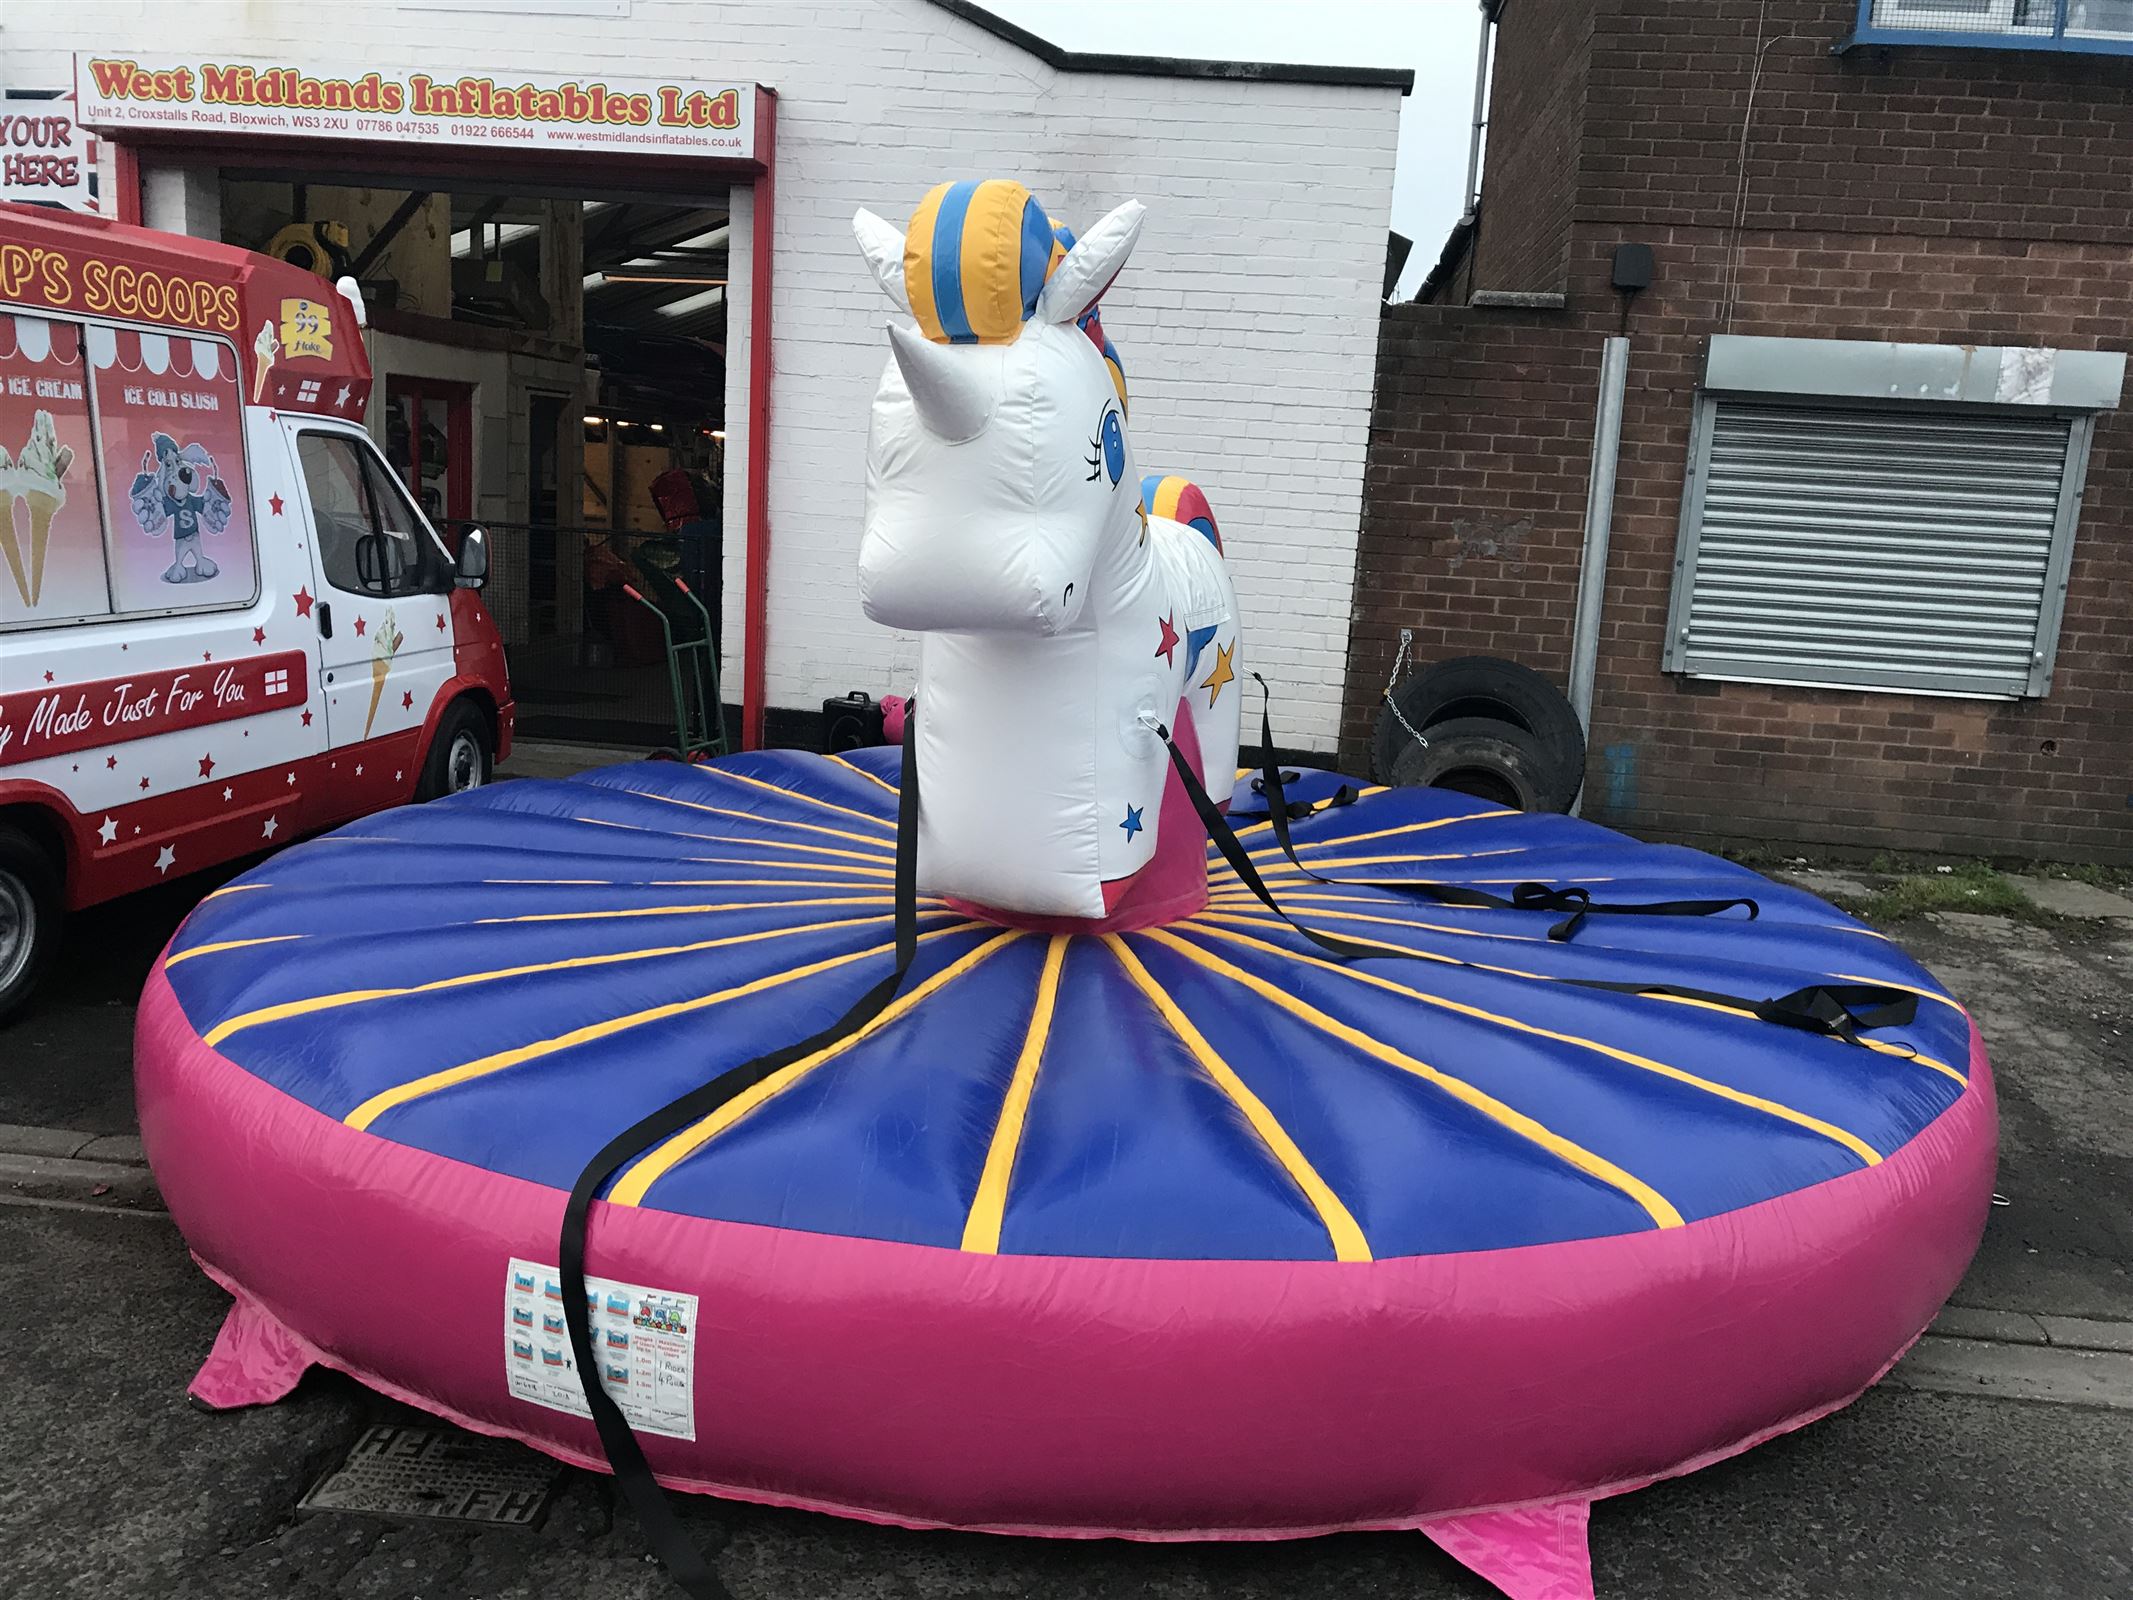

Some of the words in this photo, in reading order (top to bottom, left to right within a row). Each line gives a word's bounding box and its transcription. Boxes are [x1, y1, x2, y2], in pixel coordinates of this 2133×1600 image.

[90, 59, 194, 101] West
[200, 64, 404, 114] Midlands
[409, 74, 652, 127] Inflatables
[657, 86, 740, 129] Ltd
[0, 115, 72, 148] YOUR
[88, 106, 112, 118] Unit
[115, 107, 125, 119] 2,
[128, 107, 188, 121] Croxstalls
[191, 110, 226, 124] Road,
[230, 112, 289, 128] Bloxwich,
[292, 115, 320, 128] WS3
[323, 117, 349, 130] 2XU
[356, 120, 393, 133] 07786
[396, 122, 439, 135] 047535
[451, 123, 487, 137] 01922
[490, 125, 534, 139] 666544
[547, 129, 742, 148] www.westmidlandsinflatables.co.uk
[3, 153, 79, 187] HERE
[0, 244, 72, 304] P'S
[83, 260, 240, 331] SCOOPS
[295, 312, 319, 335] 99
[8, 376, 32, 396] ICE
[35, 377, 82, 400] CREAM
[124, 386, 144, 406] ICE
[148, 389, 178, 408] COLD
[181, 391, 218, 411] SLUSH
[179, 509, 194, 529] S
[23, 694, 94, 746] Made
[103, 683, 159, 726] Just
[165, 674, 203, 715] For
[213, 666, 244, 708] You
